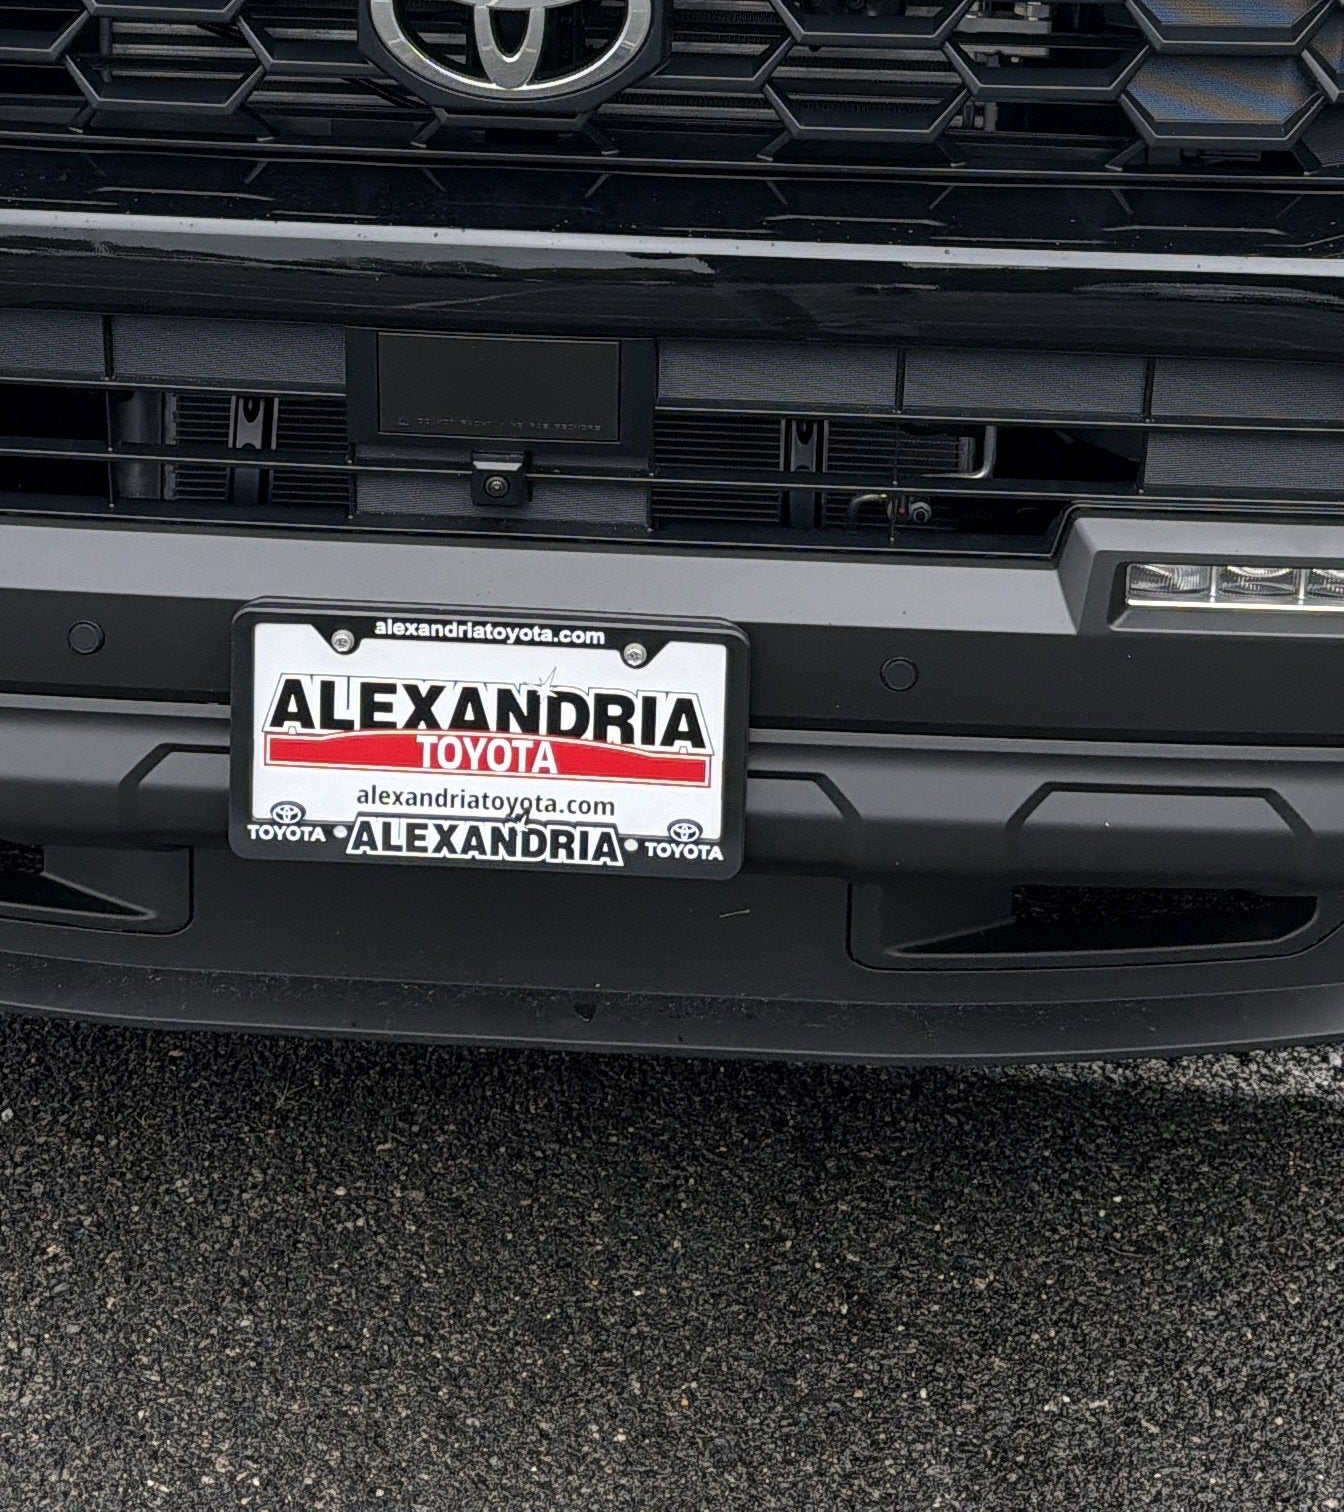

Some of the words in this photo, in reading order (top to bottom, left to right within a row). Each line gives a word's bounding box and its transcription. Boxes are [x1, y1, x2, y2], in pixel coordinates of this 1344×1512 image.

[374, 618, 606, 646] alexandriatoyota.com
[268, 676, 708, 750] ALEXANDRIA
[416, 733, 560, 775] TOYOTA
[356, 784, 616, 818] alexandriatoyota.com
[246, 823, 327, 844] TOYOTA
[349, 819, 622, 864] ALEXANDRIA
[644, 841, 725, 863] TOYOTA
